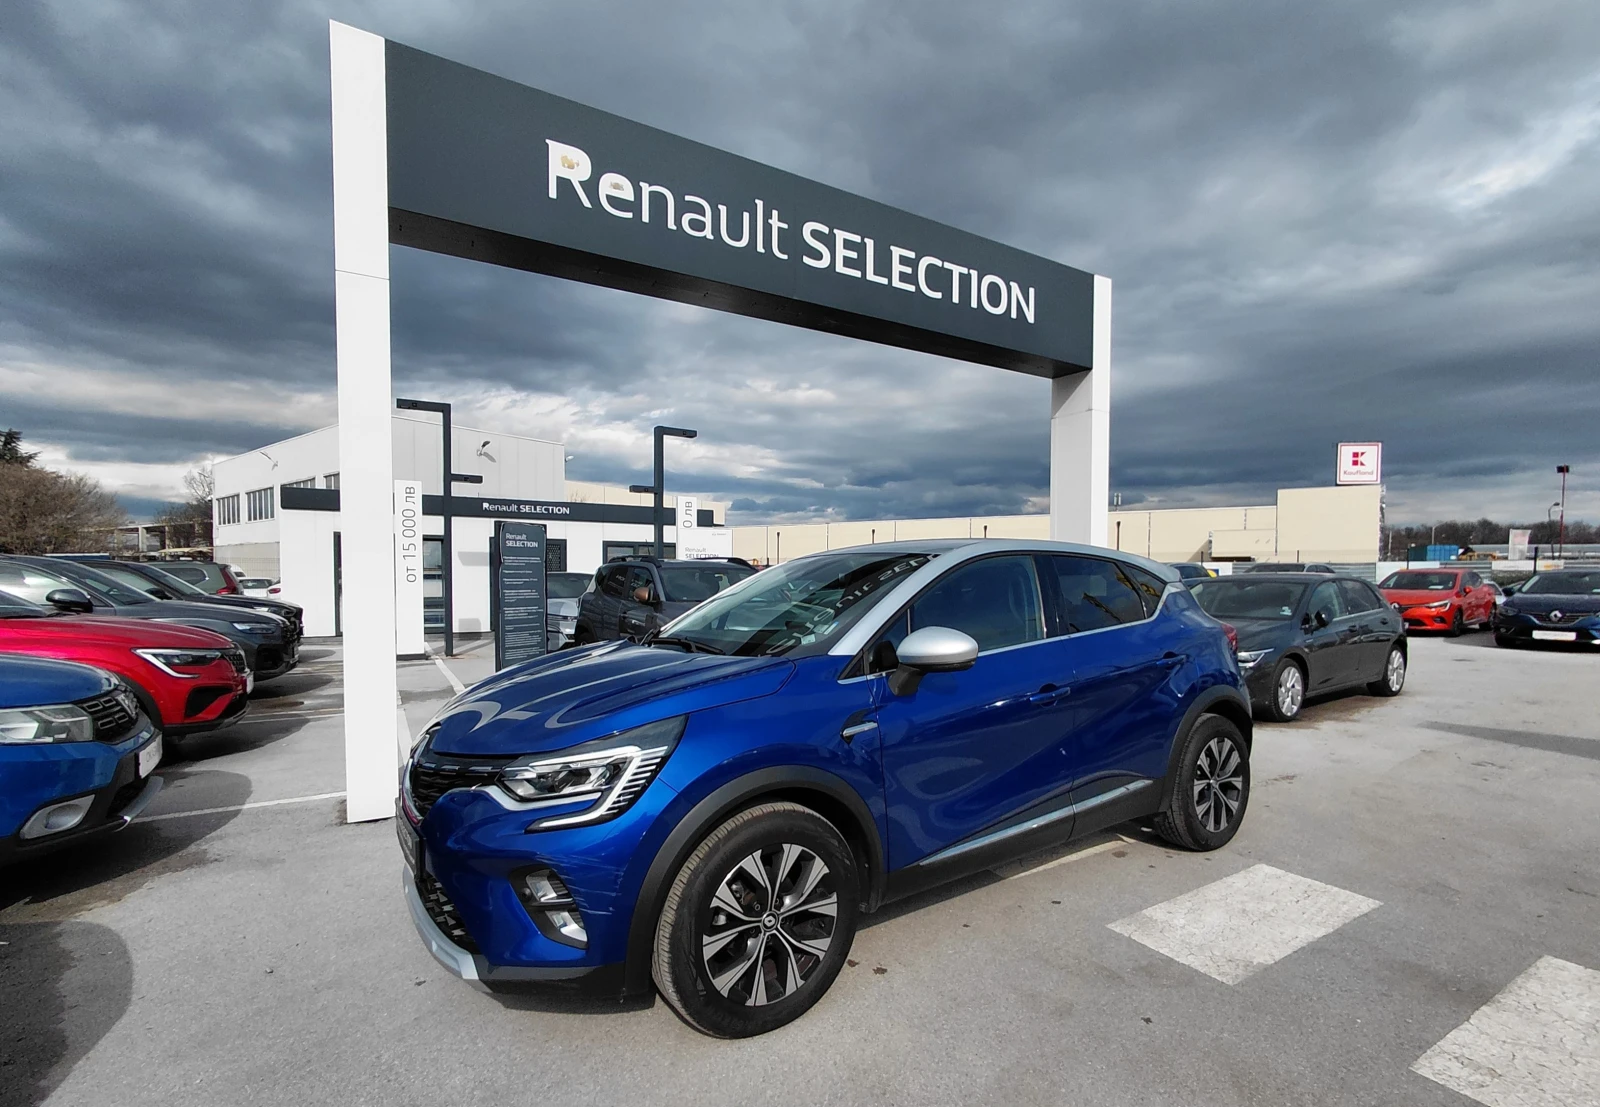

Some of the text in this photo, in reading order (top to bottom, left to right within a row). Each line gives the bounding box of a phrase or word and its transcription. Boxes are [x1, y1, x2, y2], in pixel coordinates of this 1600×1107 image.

[545, 139, 1036, 324] Renault SELECTION
[482, 502, 570, 515] Renault SELECTION
[401, 508, 417, 538] 000
[402, 543, 417, 560] 15
[505, 540, 539, 548] SELECTION
